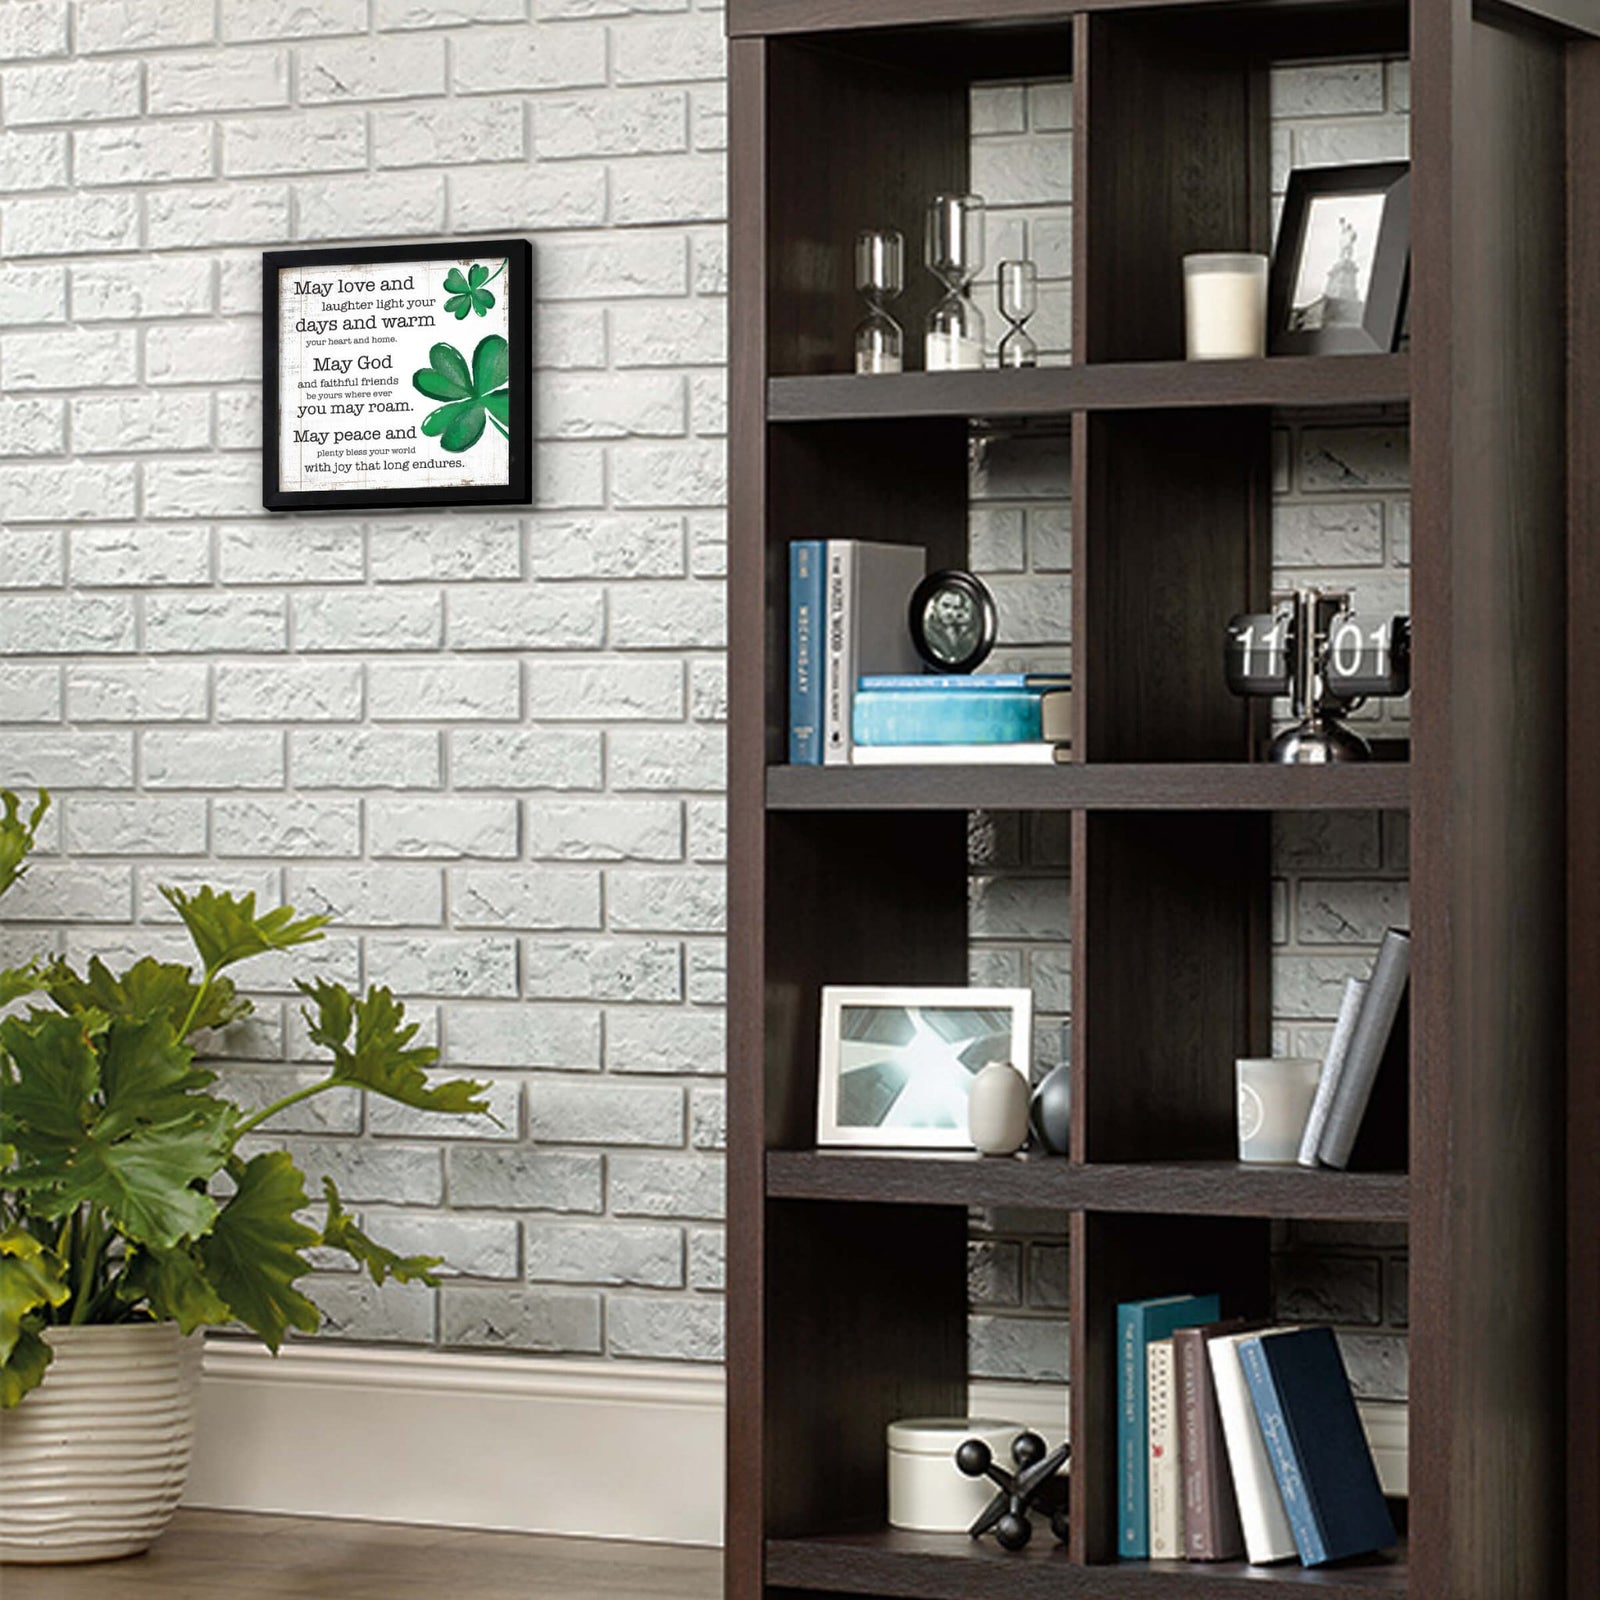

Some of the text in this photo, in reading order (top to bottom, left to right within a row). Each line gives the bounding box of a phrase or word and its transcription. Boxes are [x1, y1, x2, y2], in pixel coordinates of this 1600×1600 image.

[294, 277, 415, 297] May love and
[322, 298, 436, 312] laughter light your
[295, 315, 436, 334] days and warm
[306, 339, 327, 347] your
[328, 337, 352, 346] heart
[372, 336, 397, 344] home.
[313, 355, 393, 373] May God
[297, 377, 399, 389] and faithful friends
[307, 390, 392, 401] be yours where ever
[297, 401, 414, 418] you may roam.
[293, 426, 417, 445] May peace and
[317, 449, 344, 458] plenty
[346, 448, 367, 456] bless
[305, 459, 465, 473] with joy that long endures.
[1236, 624, 1387, 676] 11 01
